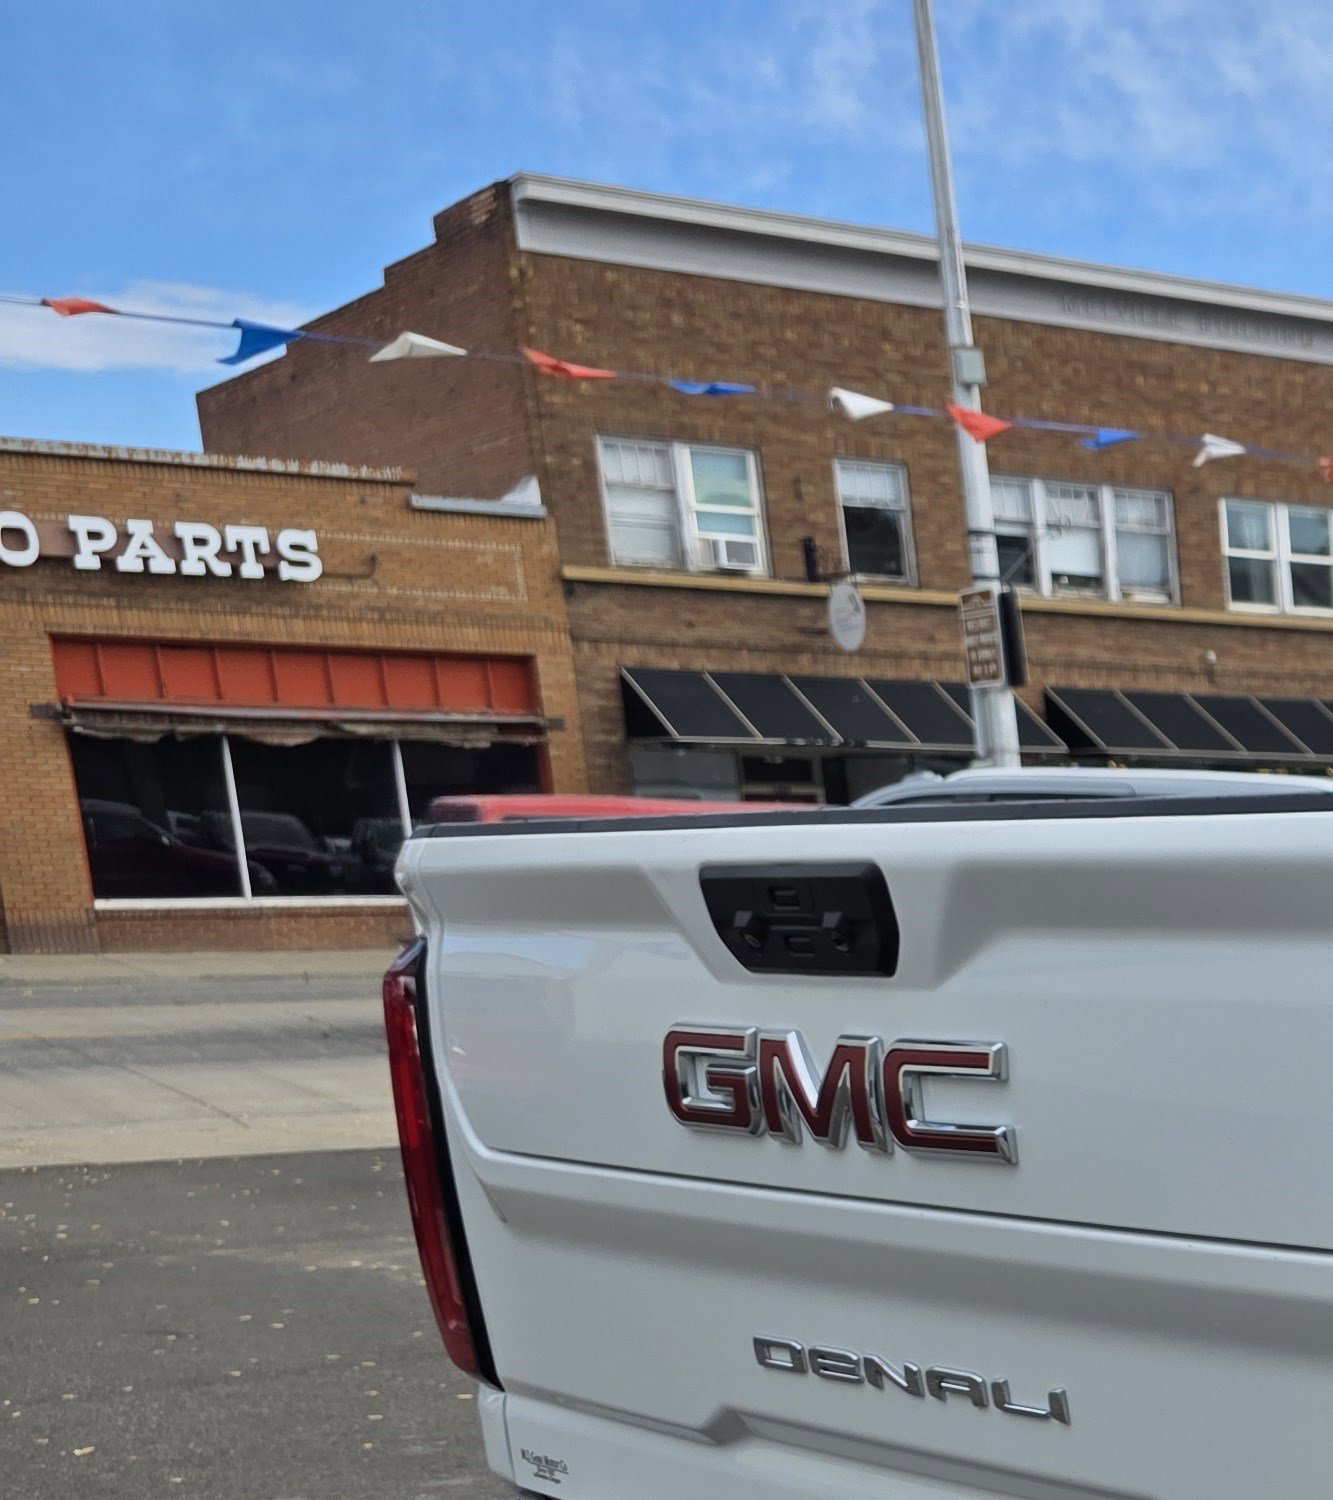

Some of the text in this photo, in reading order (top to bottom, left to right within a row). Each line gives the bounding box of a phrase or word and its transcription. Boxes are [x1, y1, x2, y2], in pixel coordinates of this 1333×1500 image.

[68, 514, 324, 583] PARTS
[661, 1021, 1020, 1166] GMC
[752, 1333, 1072, 1426] DENALI
